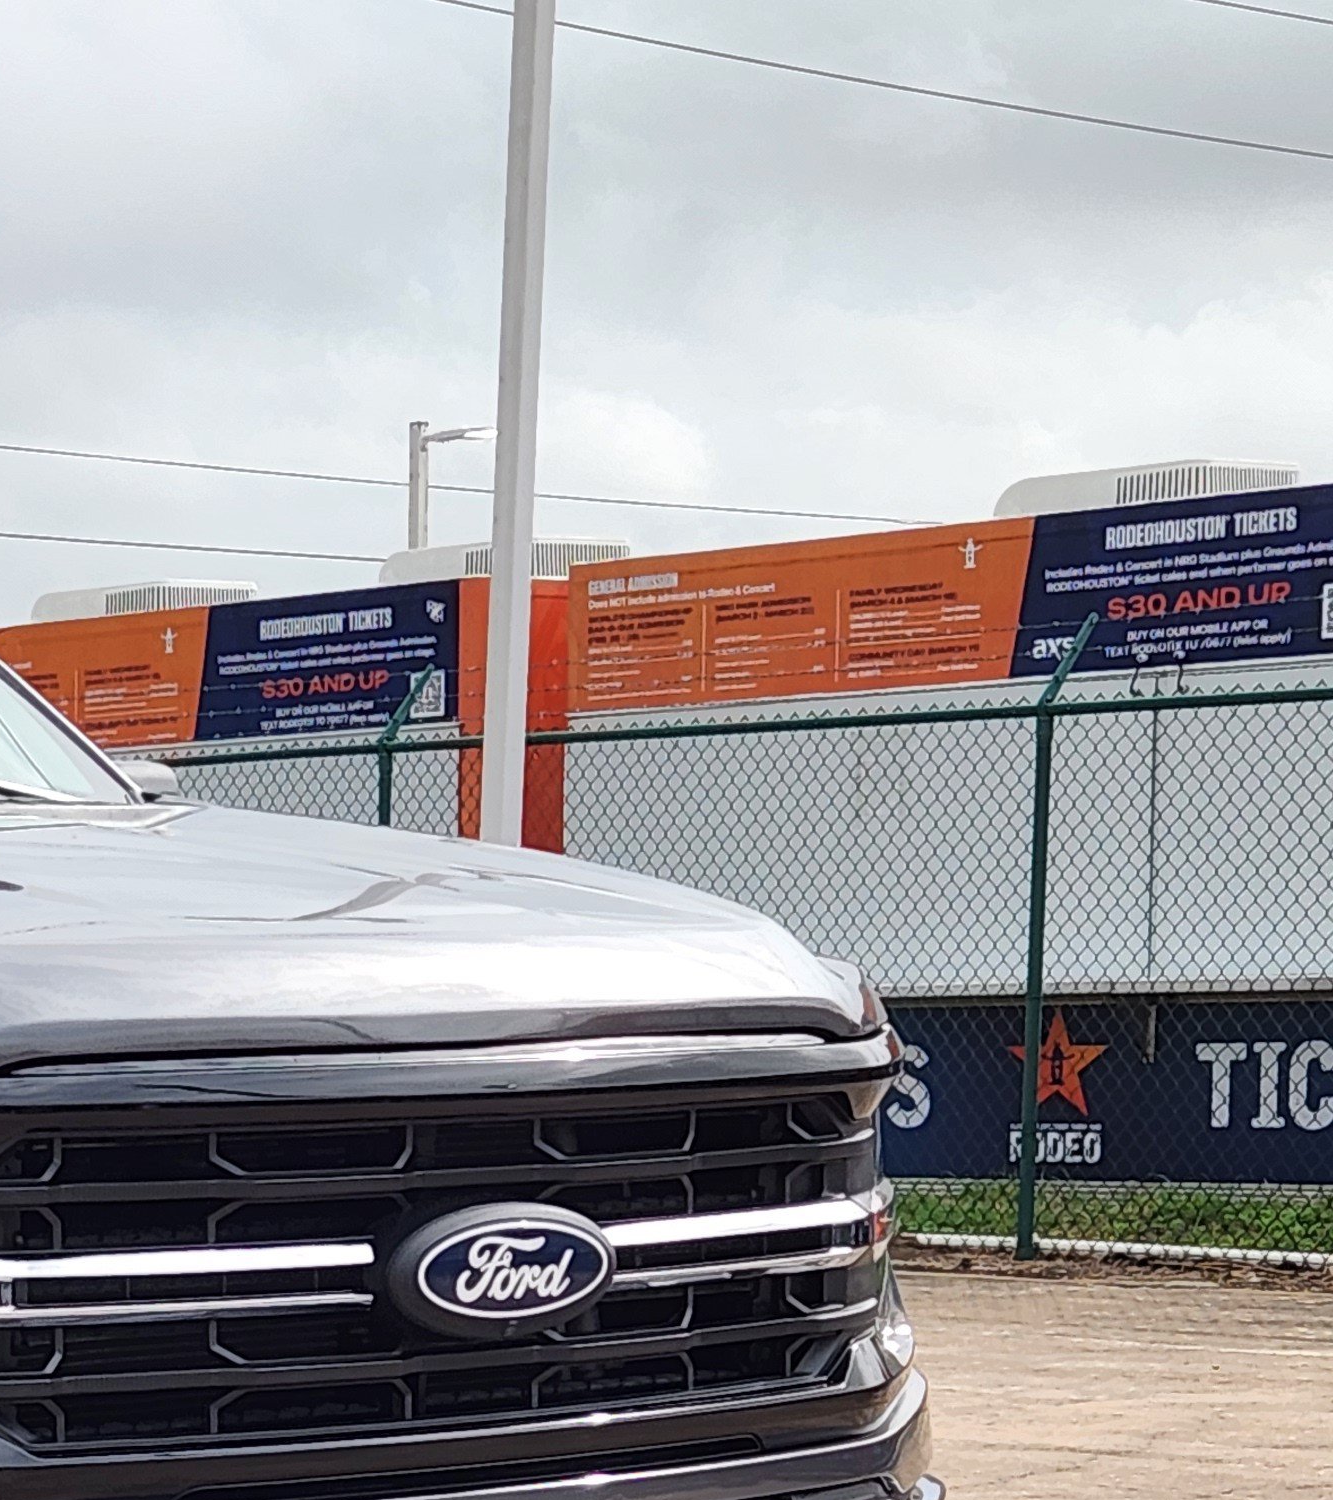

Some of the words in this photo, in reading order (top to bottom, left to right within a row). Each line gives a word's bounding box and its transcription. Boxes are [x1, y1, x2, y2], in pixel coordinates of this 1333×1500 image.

[1233, 506, 1297, 537] TICKETS
[1174, 586, 1241, 614] AND
[1249, 581, 1291, 604] UP
[348, 607, 392, 632] TICKETS
[308, 672, 355, 695] AND
[358, 669, 390, 690] UP
[455, 1236, 575, 1303] Ford
